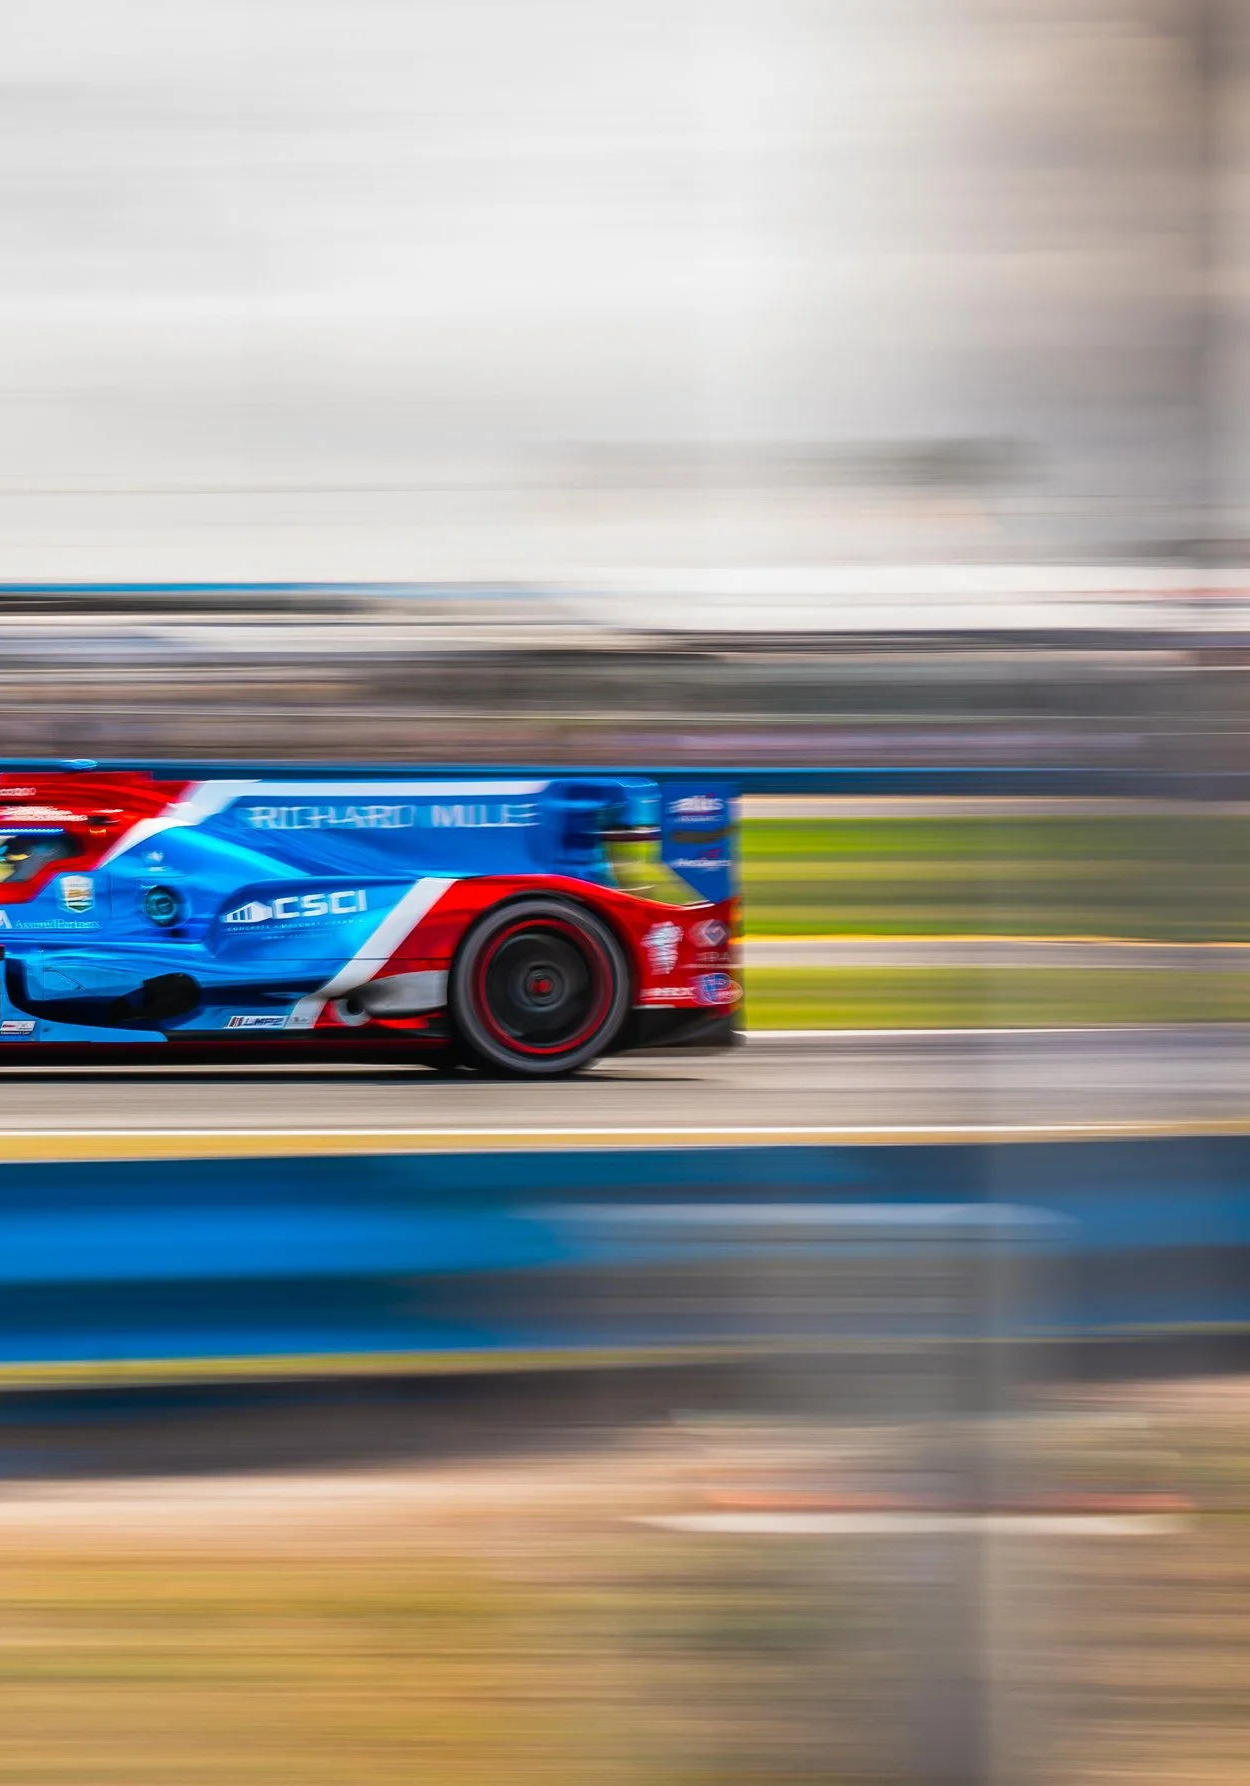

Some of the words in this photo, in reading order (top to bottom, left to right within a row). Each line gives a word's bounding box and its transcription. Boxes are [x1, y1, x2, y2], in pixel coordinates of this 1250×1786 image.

[247, 804, 417, 829] RICHARD
[432, 803, 538, 828] MILE
[272, 889, 367, 919] CSCI
[244, 1017, 285, 1026] LMP2
